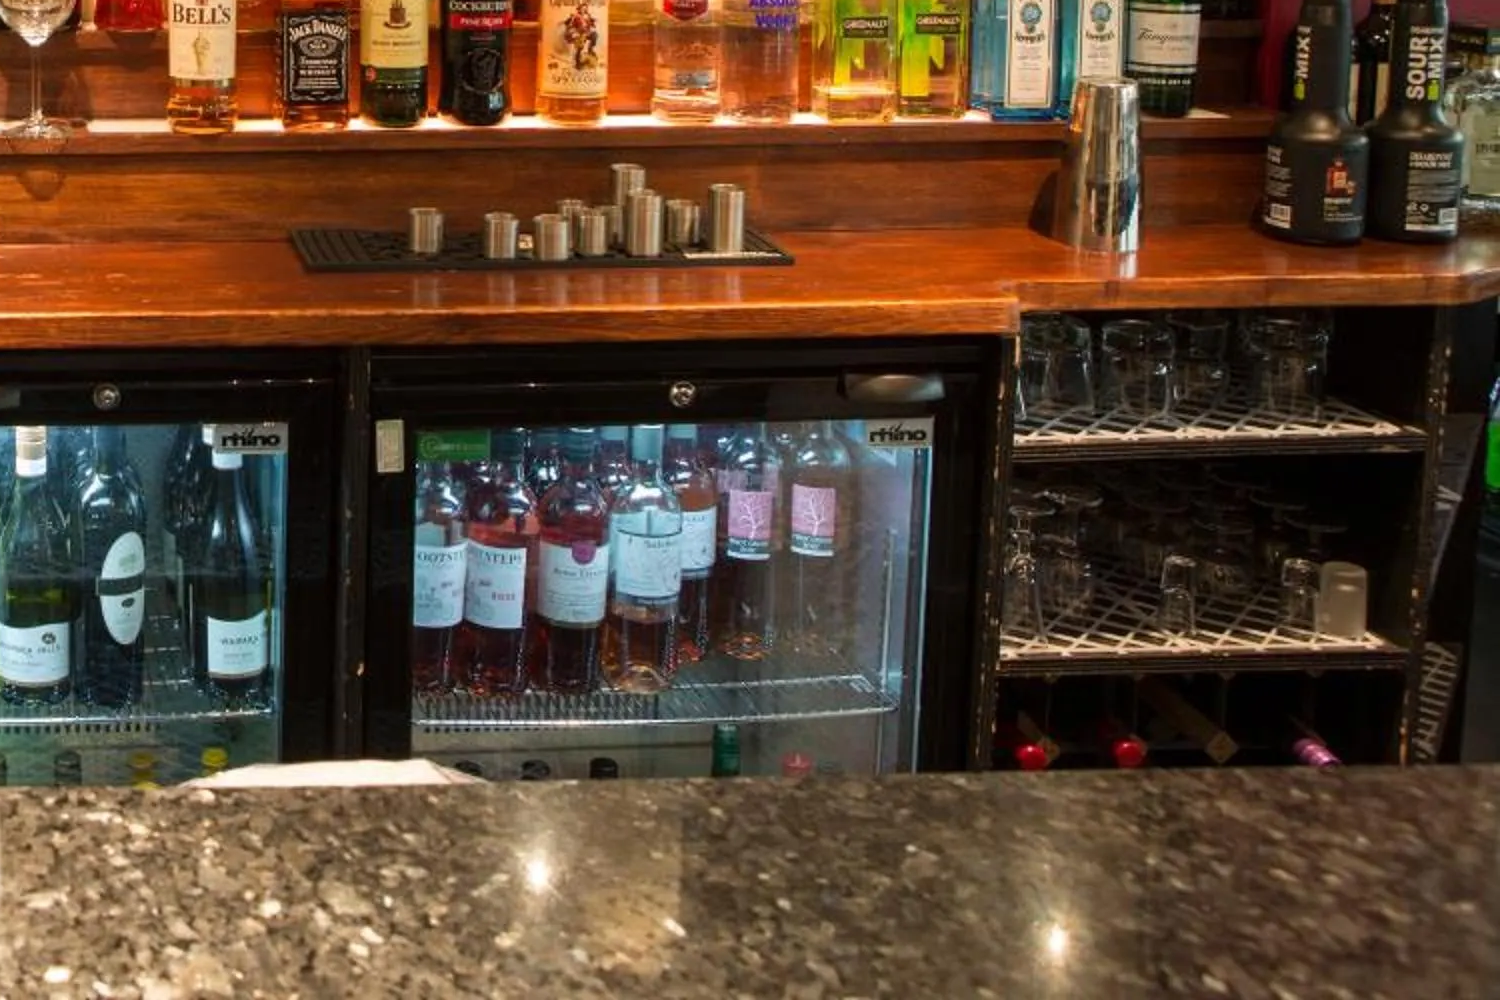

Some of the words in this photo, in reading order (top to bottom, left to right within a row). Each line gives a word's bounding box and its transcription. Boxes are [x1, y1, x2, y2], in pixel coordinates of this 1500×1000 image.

[172, 3, 232, 25] BELL'S
[219, 428, 281, 449] rhino
[868, 423, 928, 442] rhino
